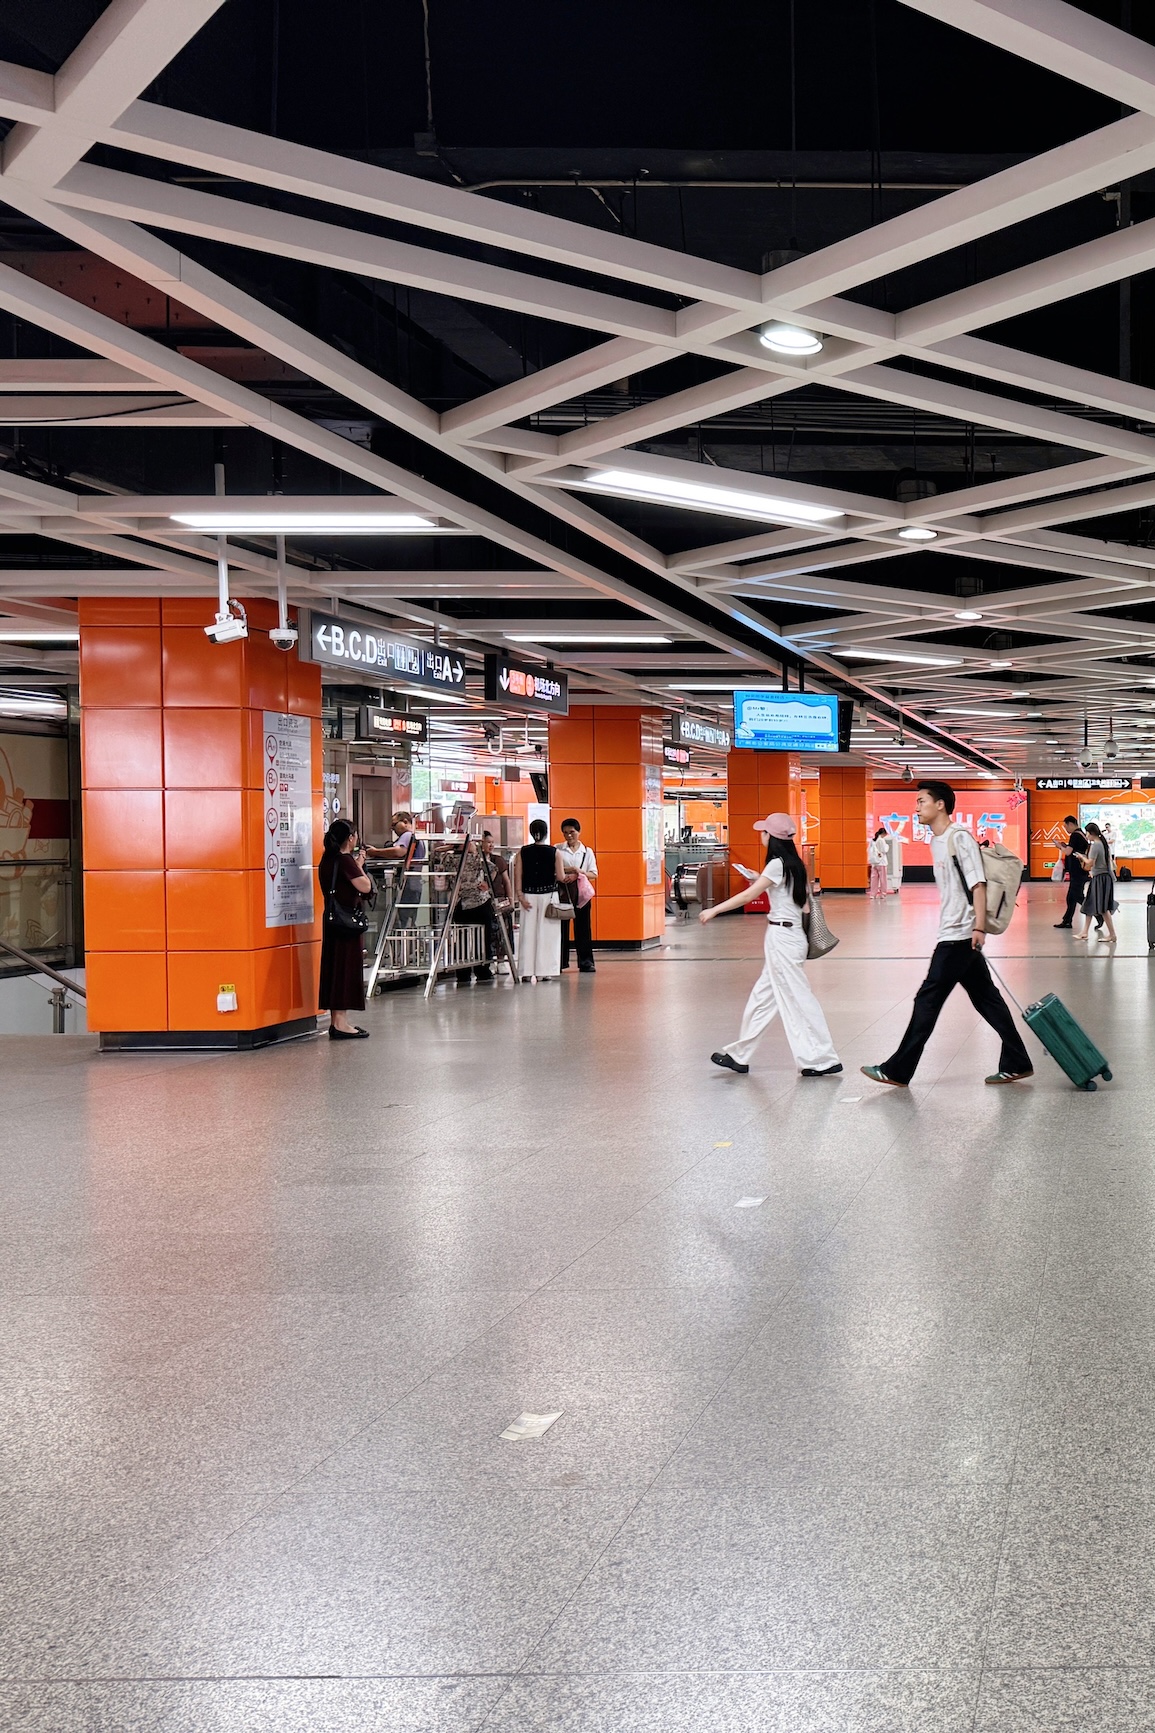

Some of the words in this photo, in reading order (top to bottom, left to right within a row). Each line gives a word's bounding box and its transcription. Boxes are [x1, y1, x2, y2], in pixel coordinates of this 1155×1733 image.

[331, 625, 378, 664] B.C.D
[377, 638, 395, 660] 出口
[427, 651, 442, 670] 出口
[442, 656, 453, 682] A
[684, 721, 700, 740] B.C.D
